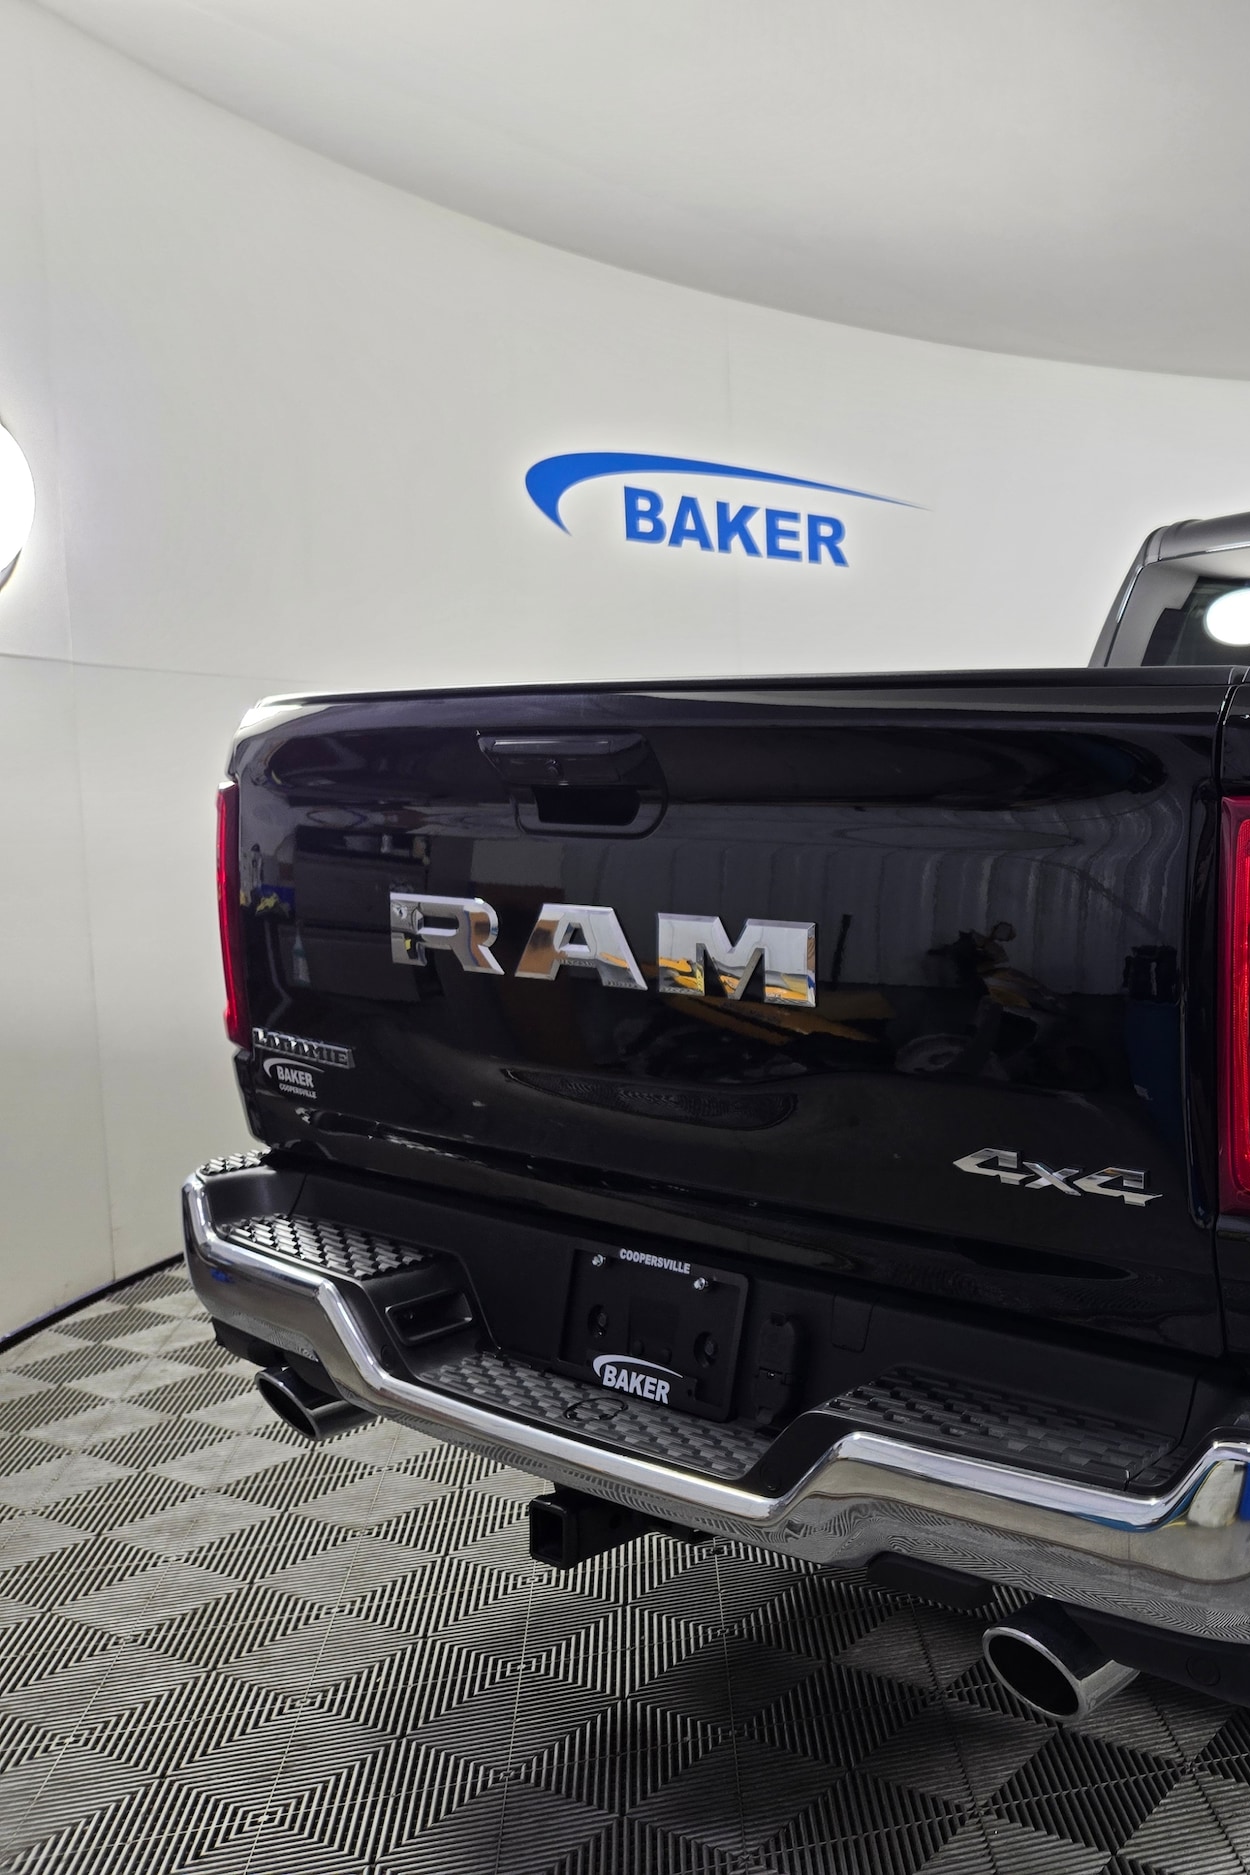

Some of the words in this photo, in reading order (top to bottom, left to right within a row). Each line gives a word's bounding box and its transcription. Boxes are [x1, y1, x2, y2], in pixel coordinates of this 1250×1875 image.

[624, 485, 850, 568] BAKER
[390, 892, 817, 1007] RAM
[276, 1065, 314, 1088] BAKER
[619, 1248, 691, 1274] COOPERSVILLE
[602, 1364, 670, 1404] BAKER
